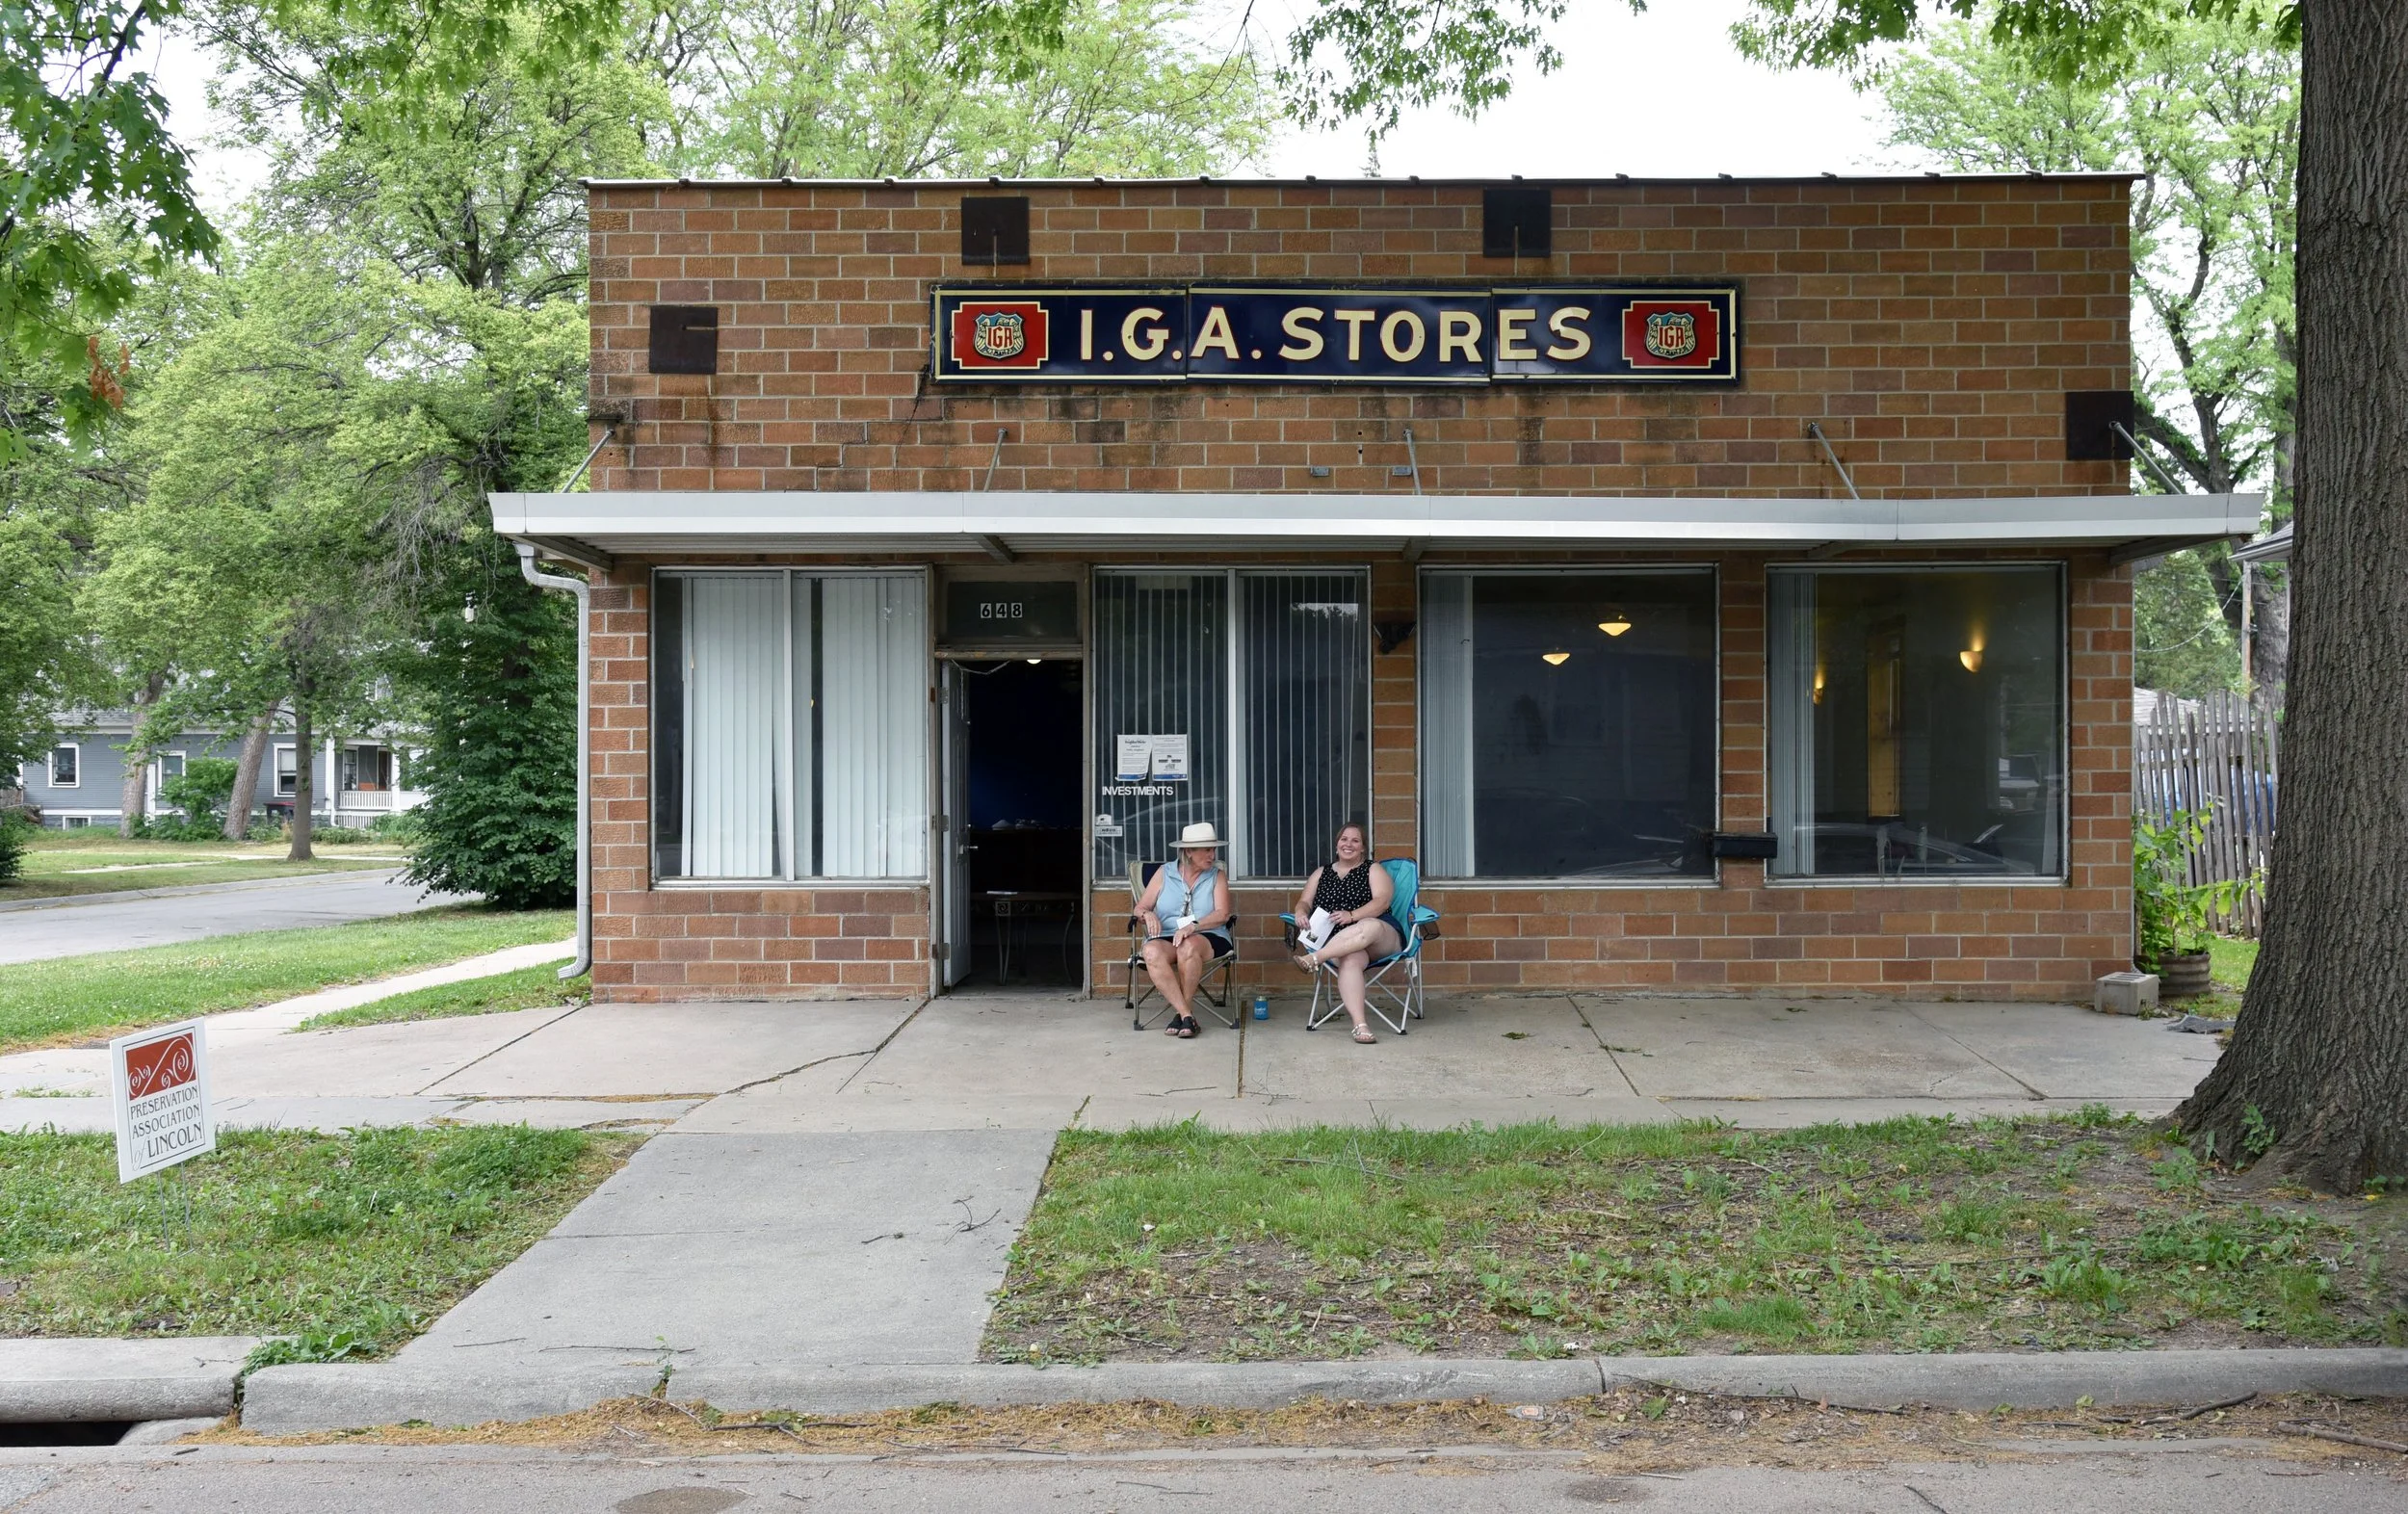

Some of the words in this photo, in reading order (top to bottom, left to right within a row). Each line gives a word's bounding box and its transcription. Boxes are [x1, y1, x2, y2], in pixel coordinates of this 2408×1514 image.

[986, 326, 1014, 349] IGA
[1277, 305, 1593, 364] STORES
[1657, 326, 1686, 349] IGA
[980, 602, 1023, 618] 648
[1102, 786, 1174, 796] INVESTMENTS
[130, 1084, 198, 1120] PRESERVATION
[132, 1103, 200, 1140] ASSOCIATION
[147, 1121, 203, 1159] LINCOLN
